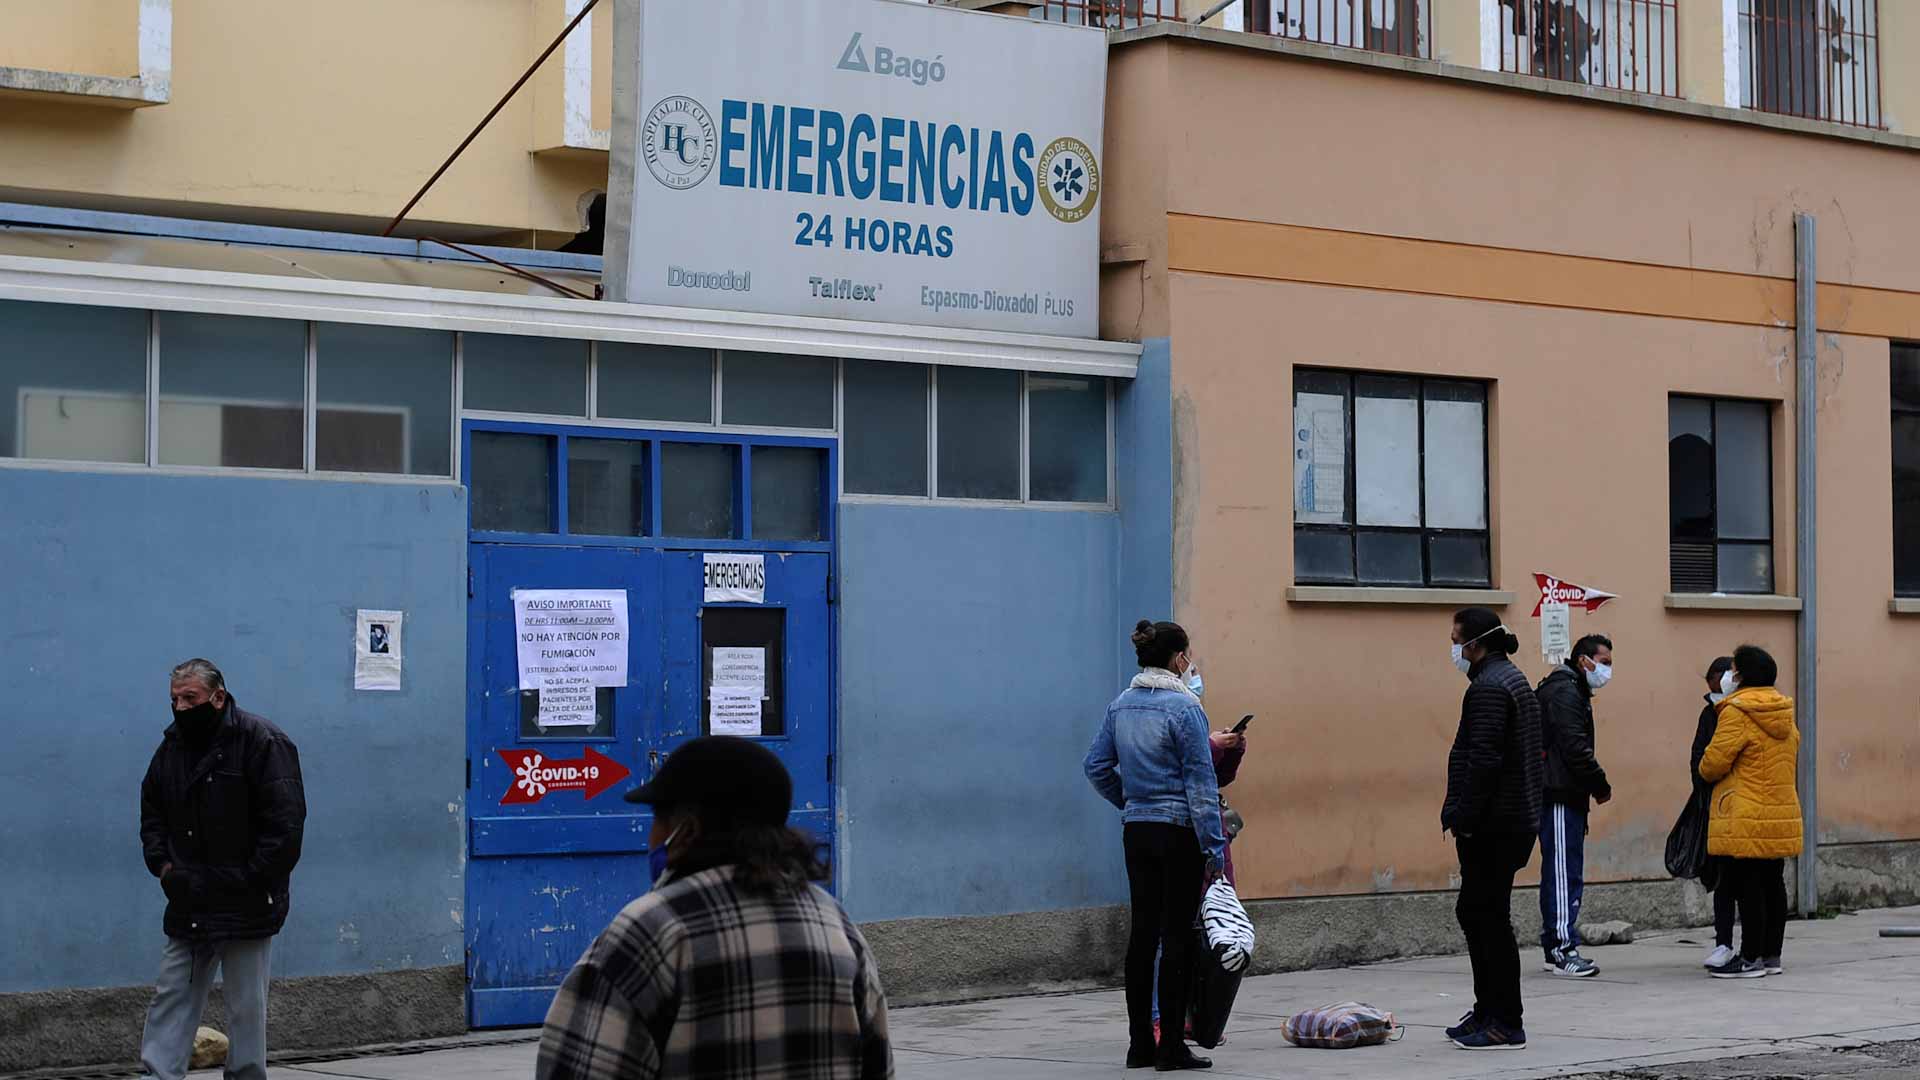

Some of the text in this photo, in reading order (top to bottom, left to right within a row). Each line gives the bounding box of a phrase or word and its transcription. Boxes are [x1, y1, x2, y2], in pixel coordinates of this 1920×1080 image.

[874, 46, 946, 86] Bagó
[646, 103, 673, 164] HOSPITAL
[675, 100, 690, 112] DE
[662, 123, 699, 166] HC
[719, 99, 1035, 216] EMERGENCIAS
[1039, 141, 1097, 192] UNIDAD DE URGENCIAS
[1052, 206, 1064, 218] La
[795, 212, 953, 258] 24 HORAS
[668, 264, 750, 292] Donodol
[921, 285, 1074, 317] Espasmo-Dioxadol PLUS
[703, 562, 764, 589] EMERGENCIAS
[527, 599, 612, 609] AVISO IMPORTANTE
[521, 633, 534, 642] NO
[536, 632, 555, 642] HAY
[601, 632, 620, 640] POR
[541, 646, 596, 659] FUMIGACIÓN
[531, 766, 599, 782] COVID-19
